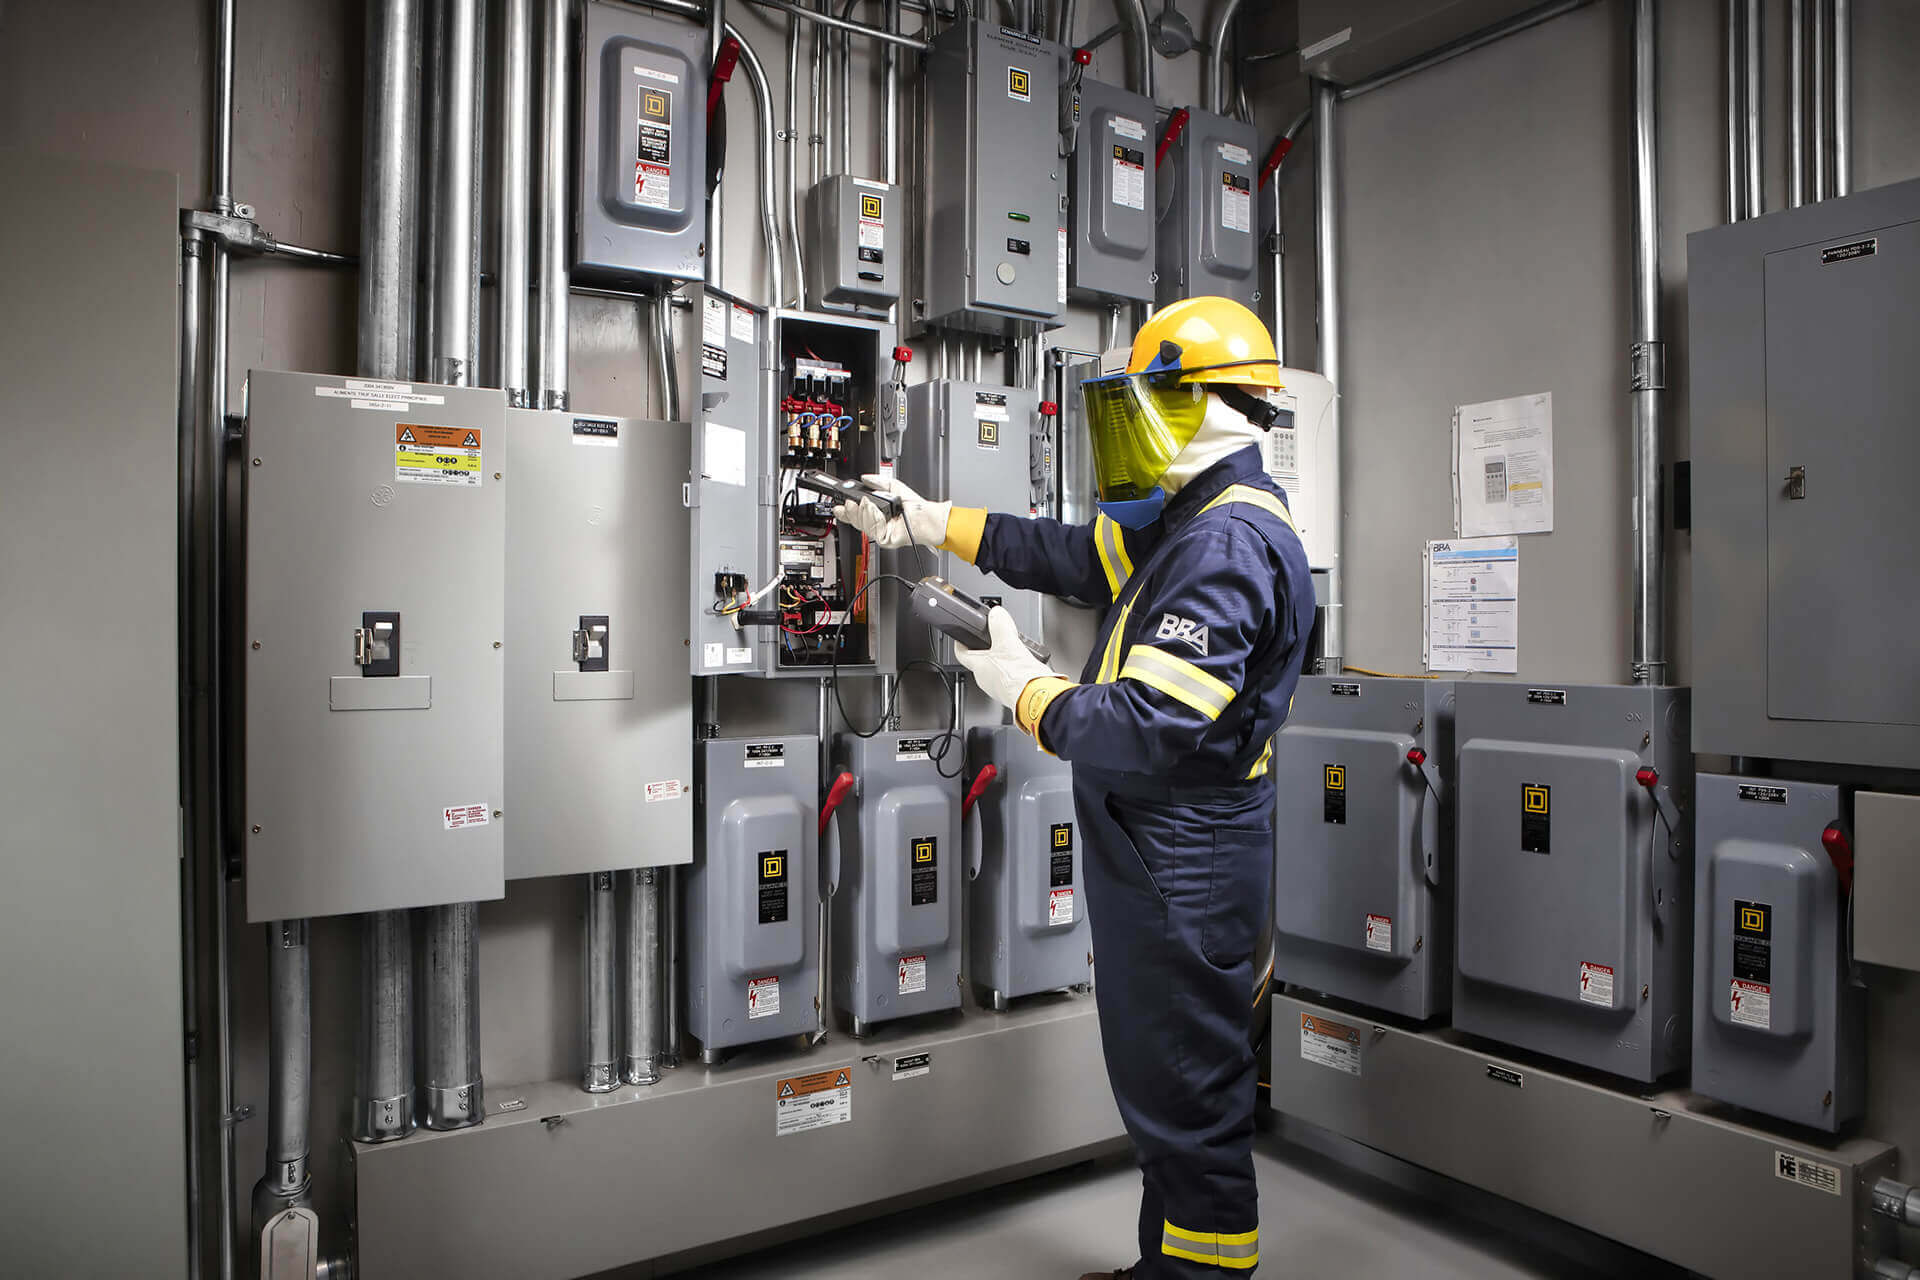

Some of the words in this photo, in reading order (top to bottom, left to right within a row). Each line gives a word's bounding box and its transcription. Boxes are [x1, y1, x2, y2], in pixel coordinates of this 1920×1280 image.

[1156, 613, 1209, 657] BBA
[1590, 964, 1612, 975] DANGER
[757, 977, 777, 986] DANGER
[1742, 983, 1767, 993] DANGER
